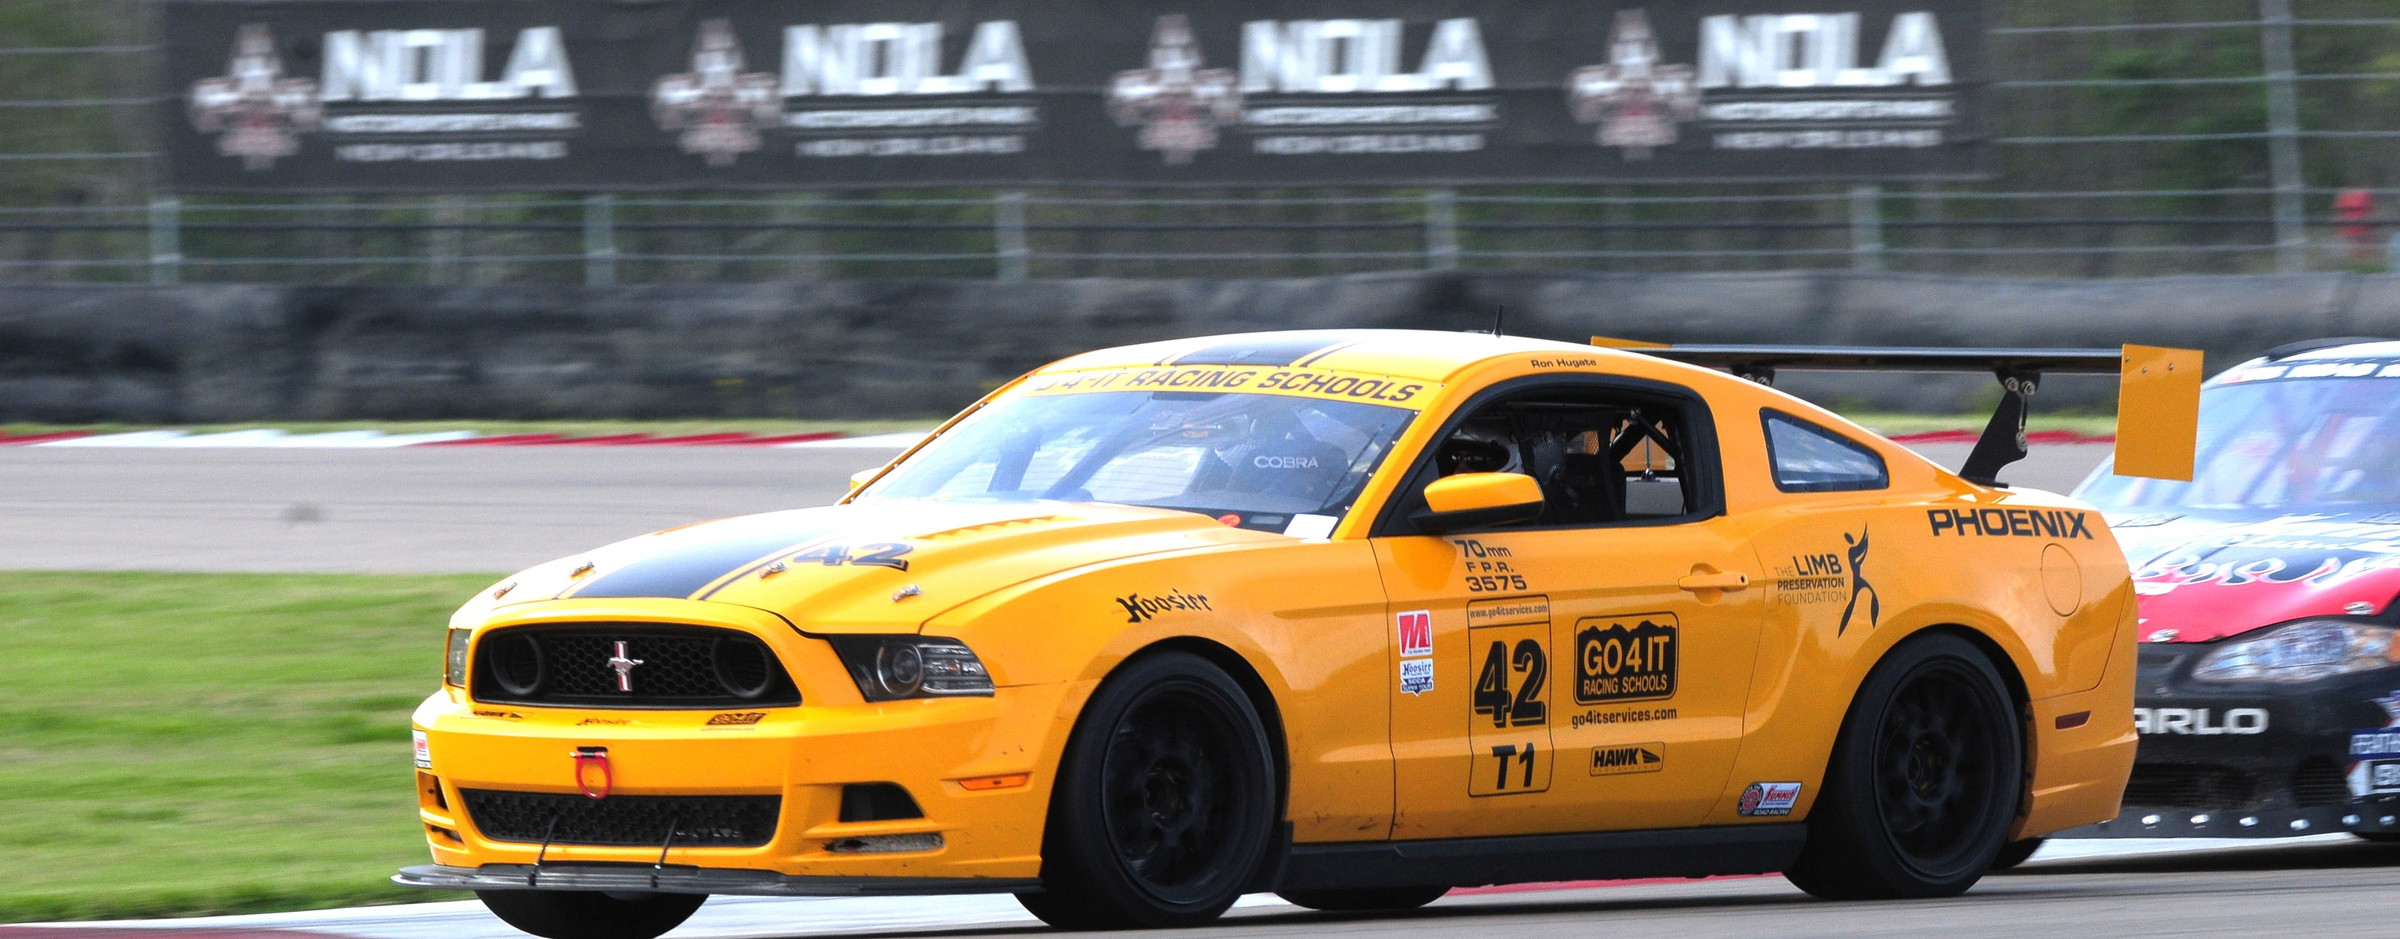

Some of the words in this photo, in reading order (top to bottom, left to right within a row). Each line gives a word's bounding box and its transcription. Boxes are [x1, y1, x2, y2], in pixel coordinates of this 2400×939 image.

[321, 26, 579, 101] NOLA
[780, 20, 1036, 96] NOLA
[1239, 17, 1496, 93] NOLA
[1697, 11, 1953, 88] NOLA
[1530, 359, 1554, 368] Ron
[1125, 370, 1256, 388] RACING
[1257, 371, 1423, 402] SCHOOLS
[1253, 455, 1319, 469] COBRA
[1927, 508, 2094, 539] PHOENIX
[793, 543, 914, 572] 42
[1773, 566, 1796, 577] THE
[1792, 553, 1843, 576] LIMB
[1465, 574, 1528, 592] 3575
[1777, 577, 1845, 591] PRESERVATION
[1115, 588, 1212, 623] Hoosier
[1778, 591, 1847, 605] FOUNDATION
[1474, 638, 1548, 729] 42
[1583, 677, 1619, 696] RACING
[1622, 673, 1668, 694] SCHOOLS
[1571, 706, 1678, 730] go4itservices.com
[1491, 742, 1535, 790] T1
[1593, 747, 1640, 768] HAWK
